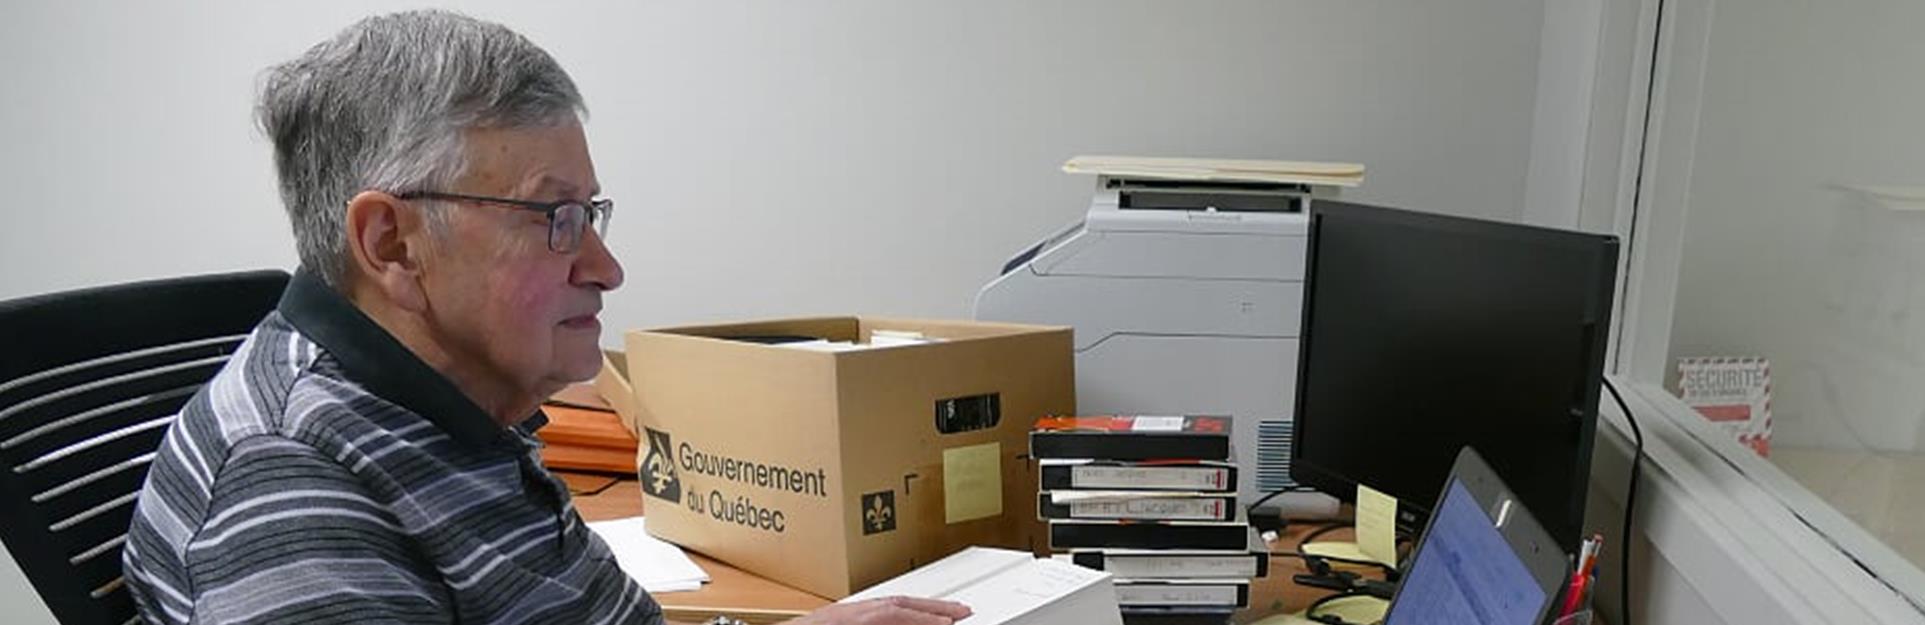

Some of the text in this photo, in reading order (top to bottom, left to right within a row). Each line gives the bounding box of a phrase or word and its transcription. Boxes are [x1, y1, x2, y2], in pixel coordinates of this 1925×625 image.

[679, 442, 827, 497] Gouvernement
[687, 484, 785, 533] du Québec
